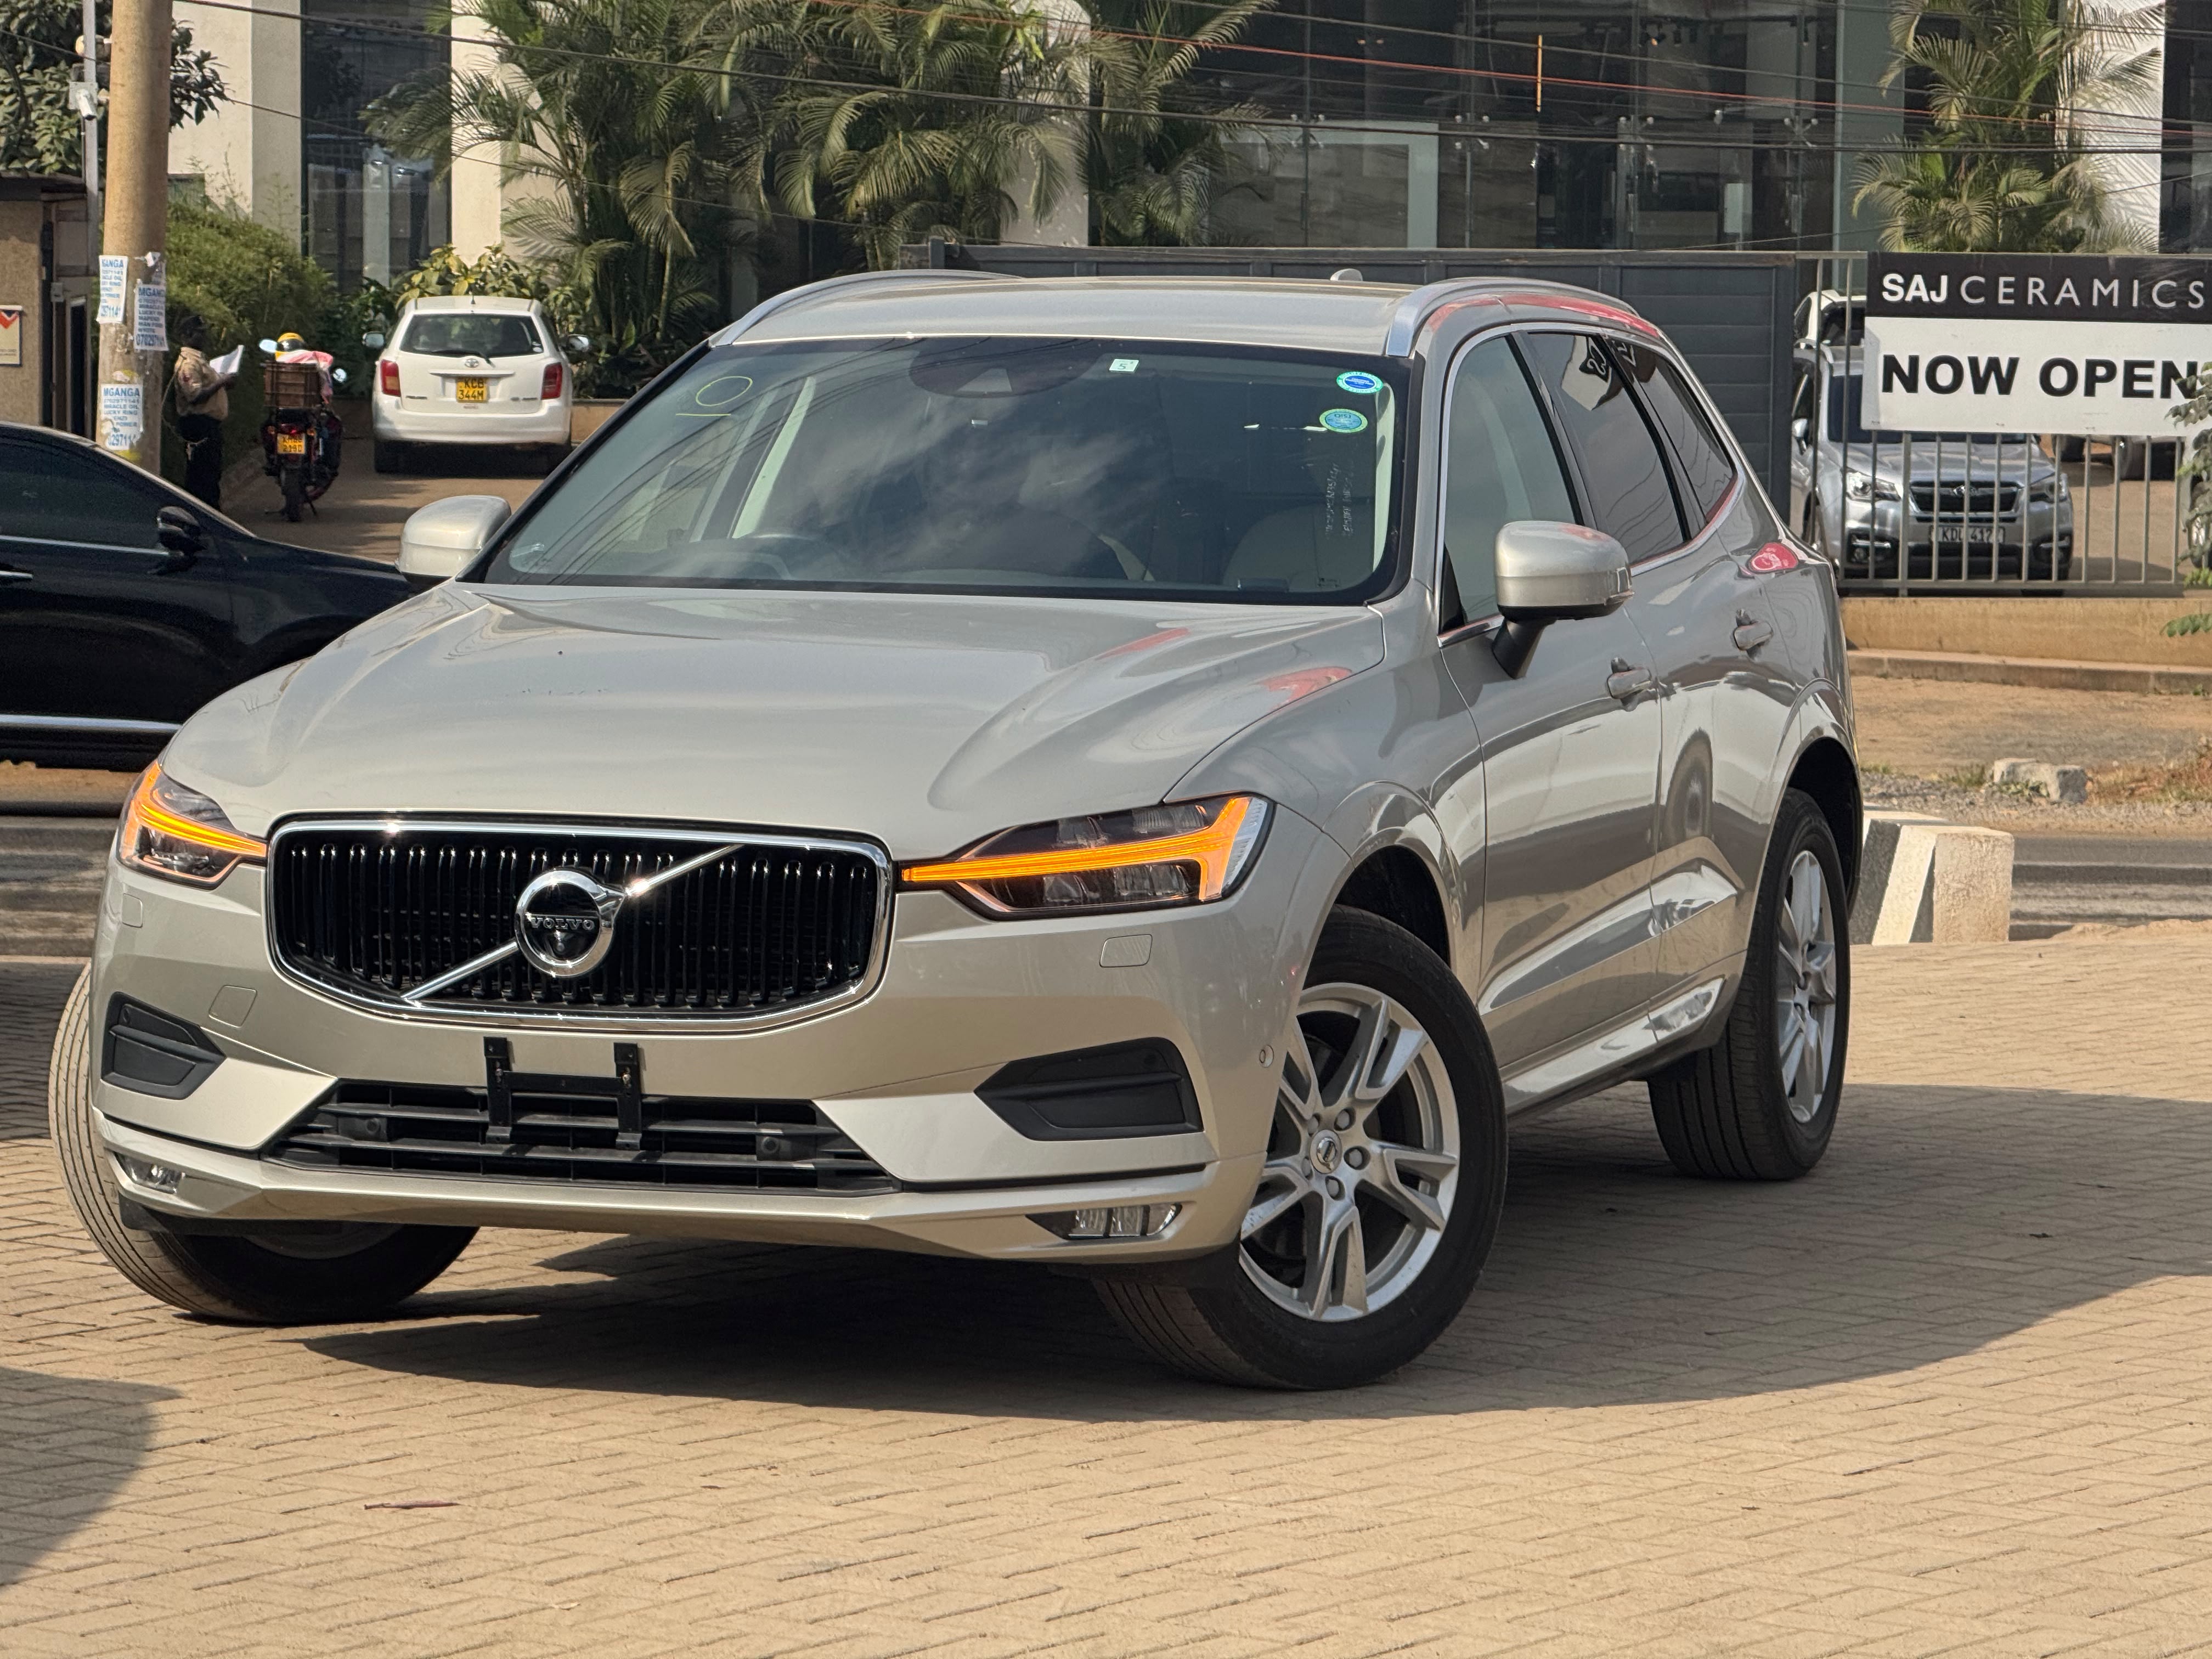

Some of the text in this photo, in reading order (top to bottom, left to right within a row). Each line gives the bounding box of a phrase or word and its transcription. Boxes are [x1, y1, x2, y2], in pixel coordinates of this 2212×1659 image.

[1882, 273, 2204, 309] SAJ CERAMICS
[1882, 354, 2198, 399] NOW OPEN
[465, 378, 484, 388] KCB
[104, 387, 140, 397] MGANGA
[458, 390, 484, 400] 344M
[529, 917, 596, 930] VOLVO
